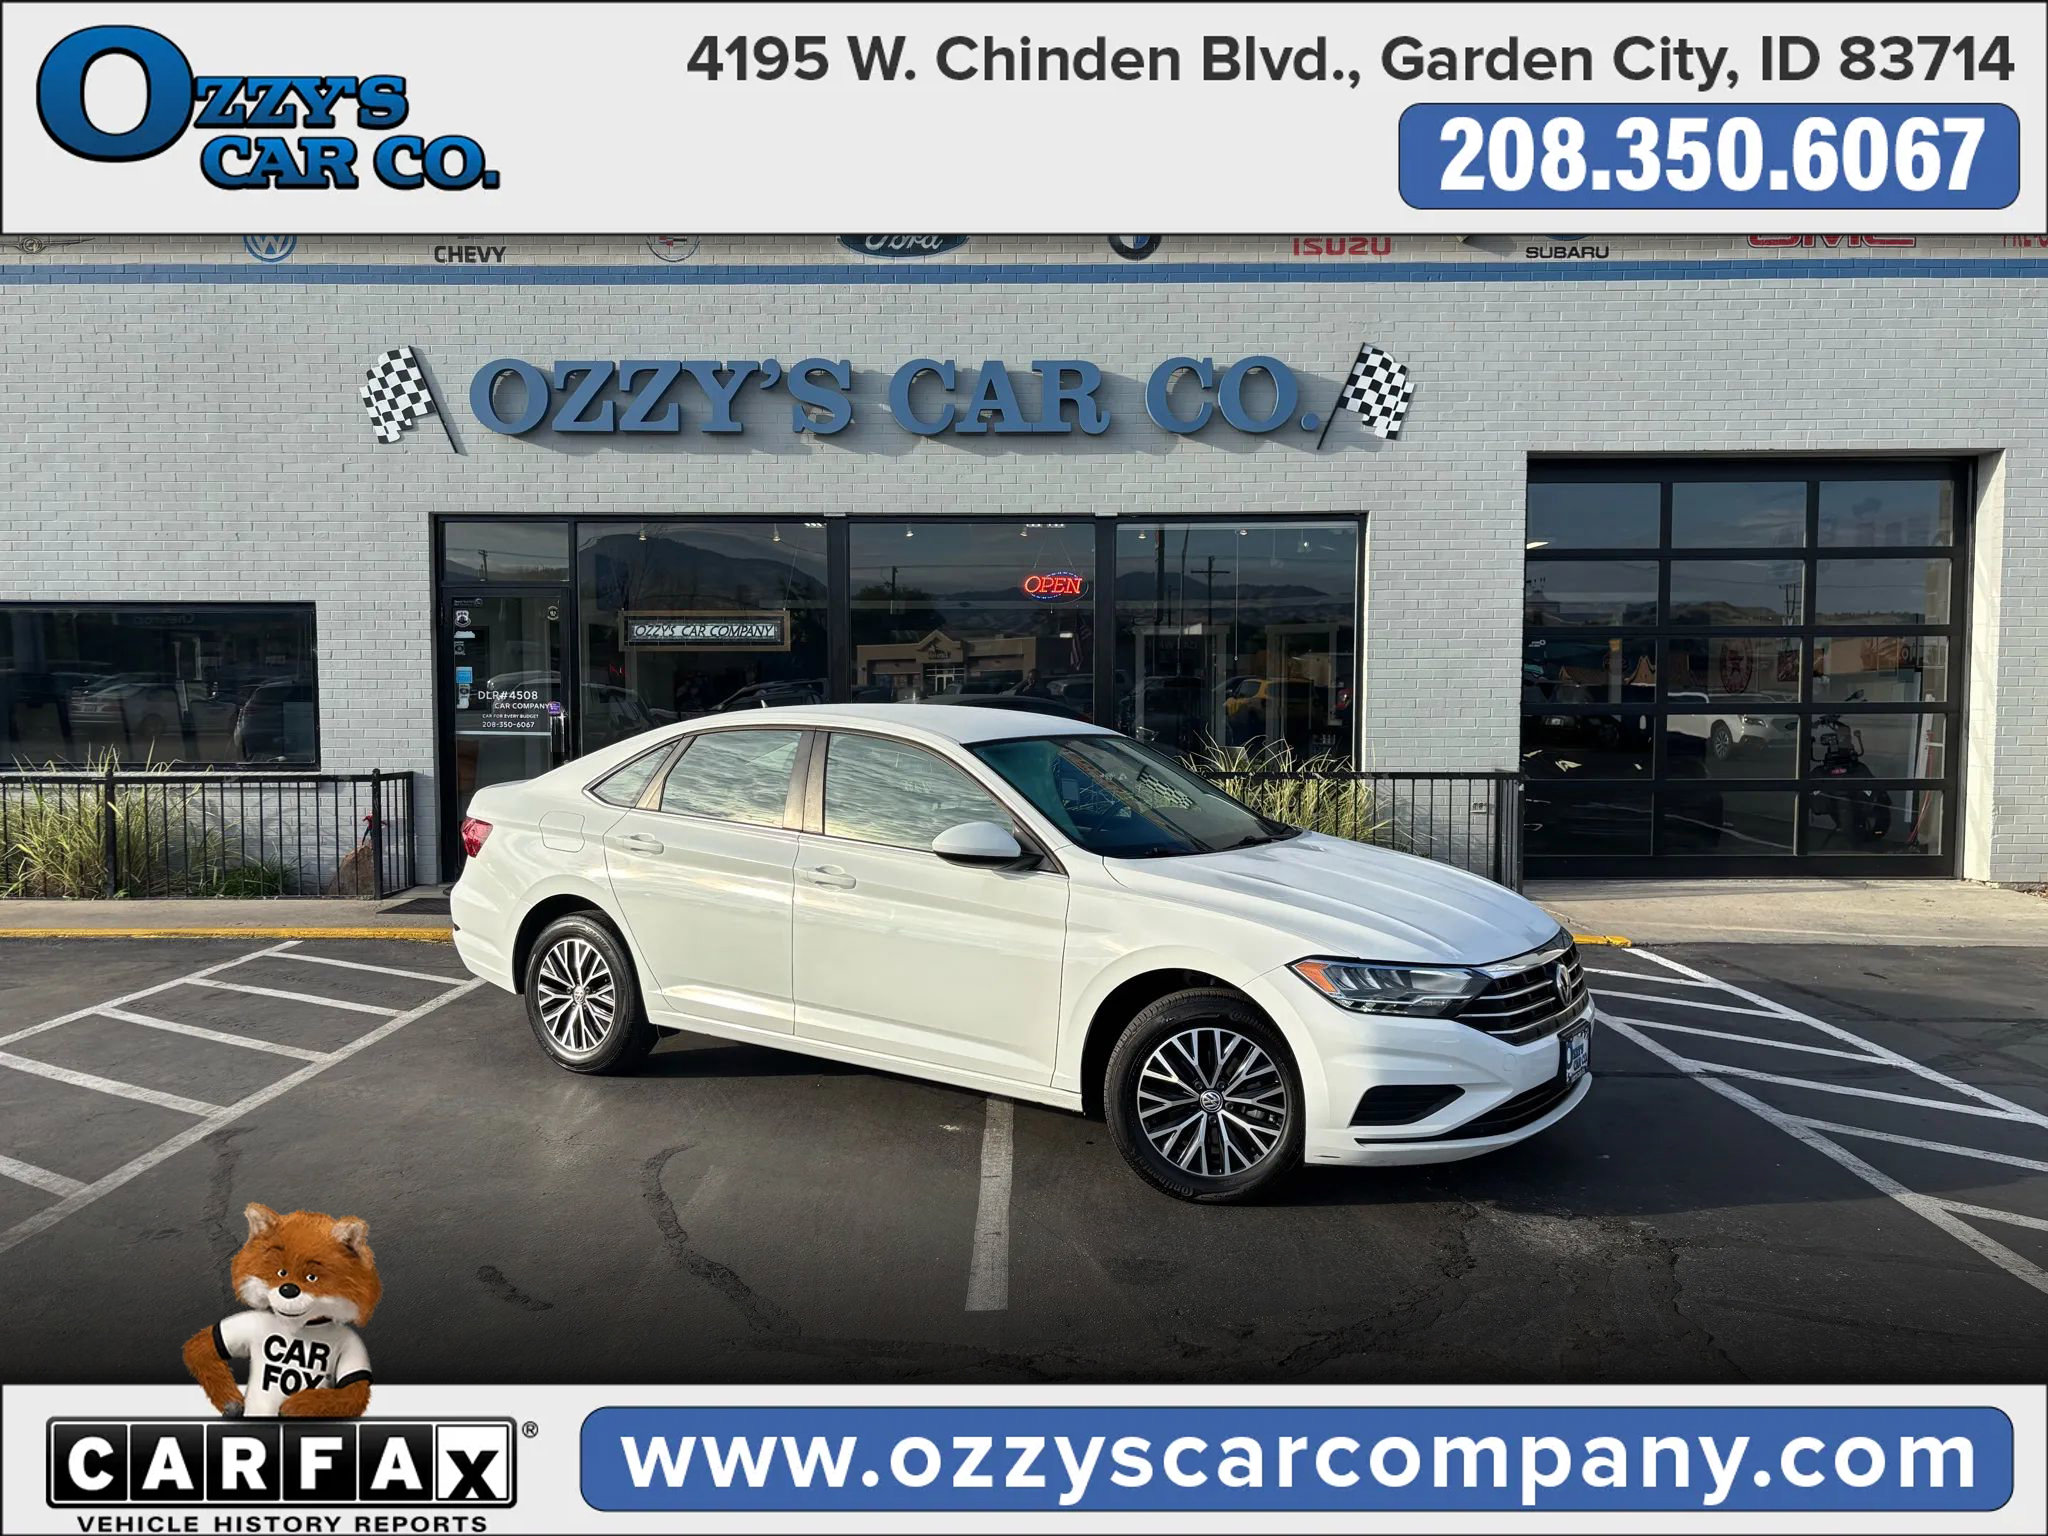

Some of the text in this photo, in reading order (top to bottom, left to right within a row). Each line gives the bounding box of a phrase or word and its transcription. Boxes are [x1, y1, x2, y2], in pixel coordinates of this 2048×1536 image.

[1293, 236, 1392, 256] ISUZU
[1526, 246, 1610, 259] SUBARU
[434, 246, 506, 263] CHEVY
[469, 356, 1320, 436] OZZY'S CAR CO.
[1024, 575, 1083, 594] OPEN
[635, 625, 773, 637] OZZY'S CAR COMPANY
[478, 690, 538, 701] DLR#4508
[494, 702, 511, 710] CAR
[512, 702, 551, 710] COMPANY
